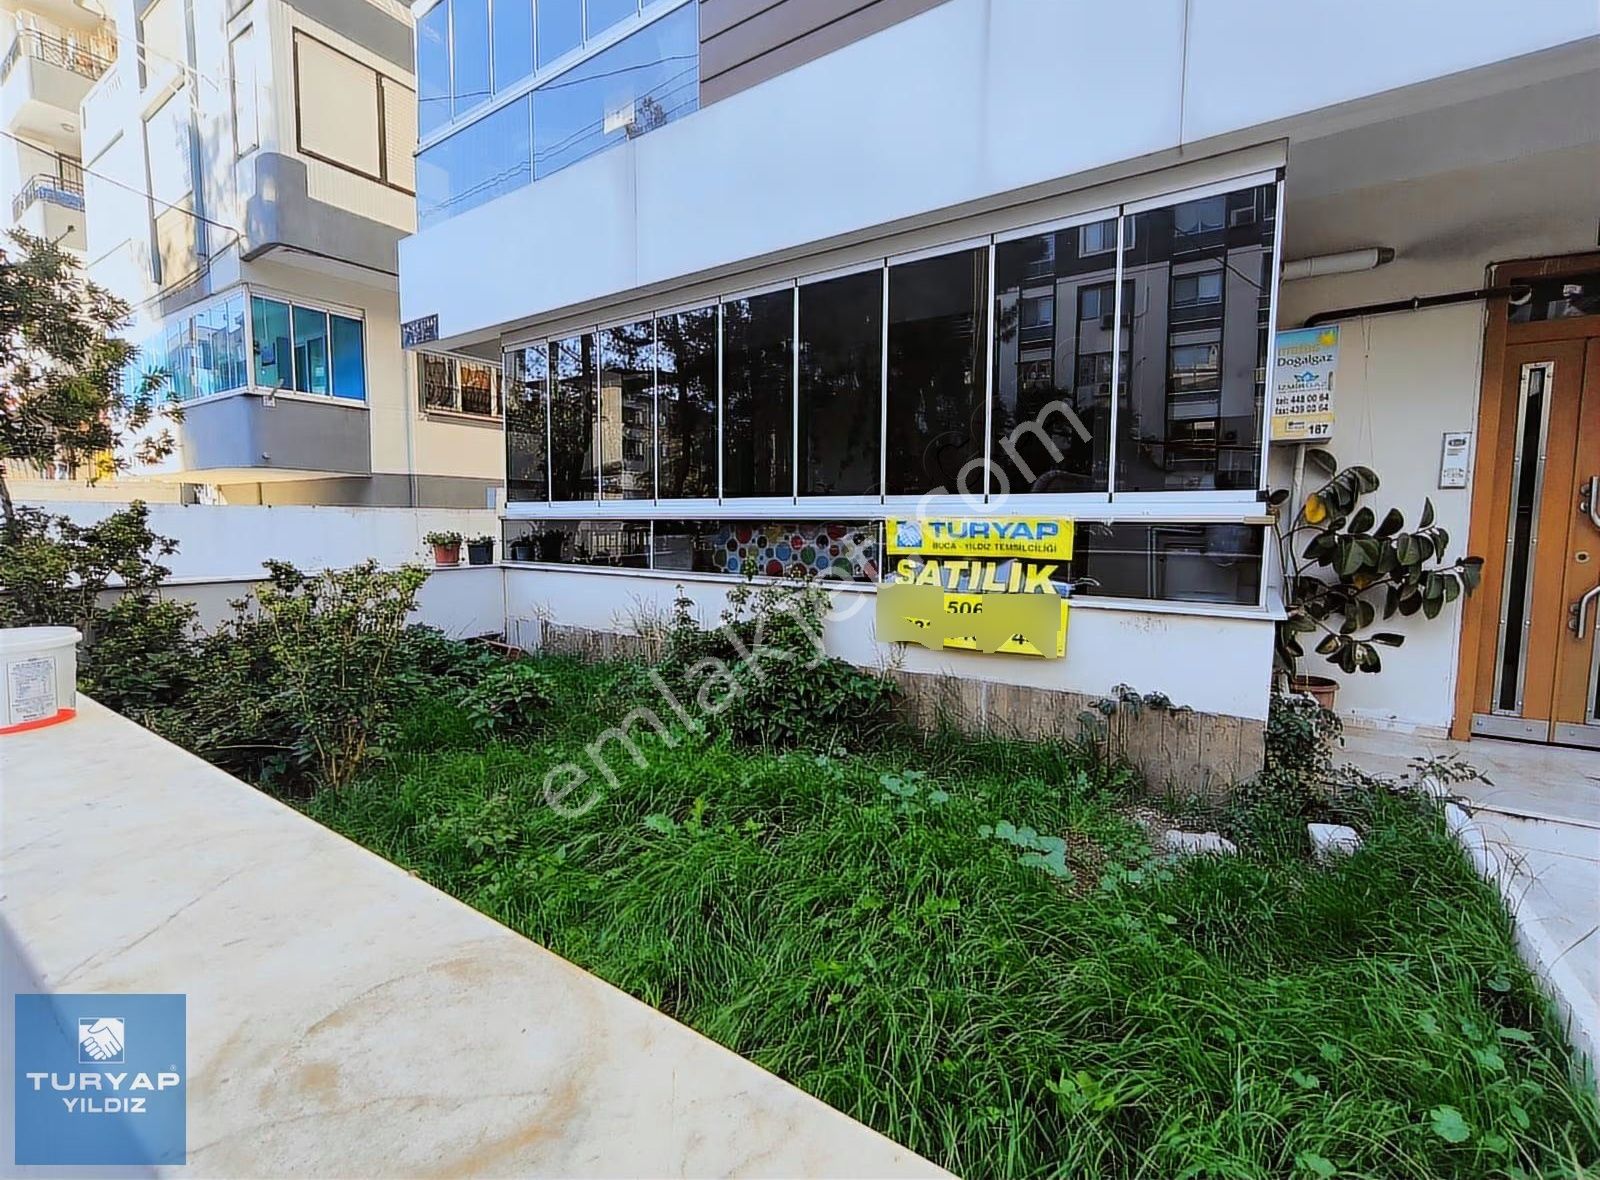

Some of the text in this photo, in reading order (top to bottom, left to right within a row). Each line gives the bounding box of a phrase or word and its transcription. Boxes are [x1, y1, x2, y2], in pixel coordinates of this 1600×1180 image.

[928, 521, 1058, 540] TURYAP
[932, 542, 957, 550] BUCA
[896, 559, 1060, 594] SATILIK
